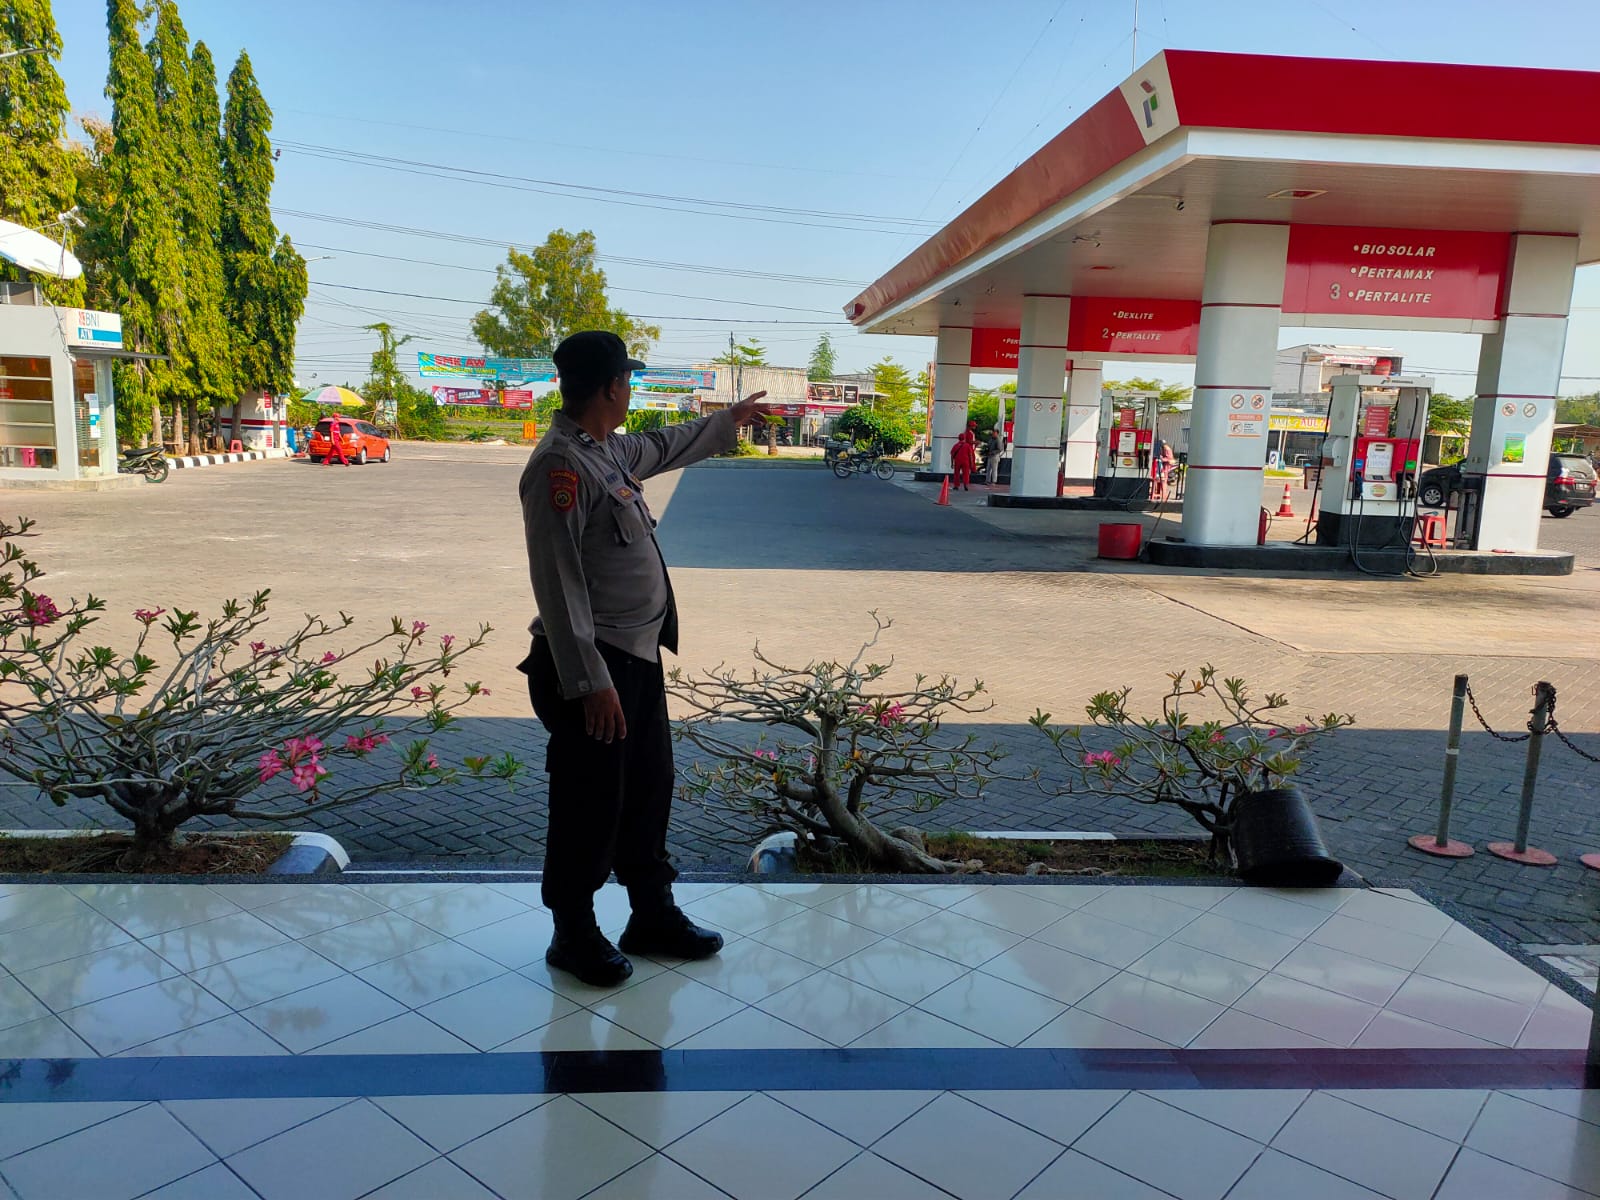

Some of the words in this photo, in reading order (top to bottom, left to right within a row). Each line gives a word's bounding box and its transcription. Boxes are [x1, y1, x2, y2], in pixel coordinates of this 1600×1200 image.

[1358, 266, 1434, 280] PERTAMAX
[1330, 283, 1341, 300] 3
[1355, 289, 1432, 303] PERTALITE
[86, 312, 100, 327] BNI
[1117, 310, 1154, 320] DEXLITE
[80, 328, 93, 340] ATM
[1102, 327, 1109, 339] 2
[1115, 331, 1161, 341] PERTALITE
[465, 357, 486, 368] AW
